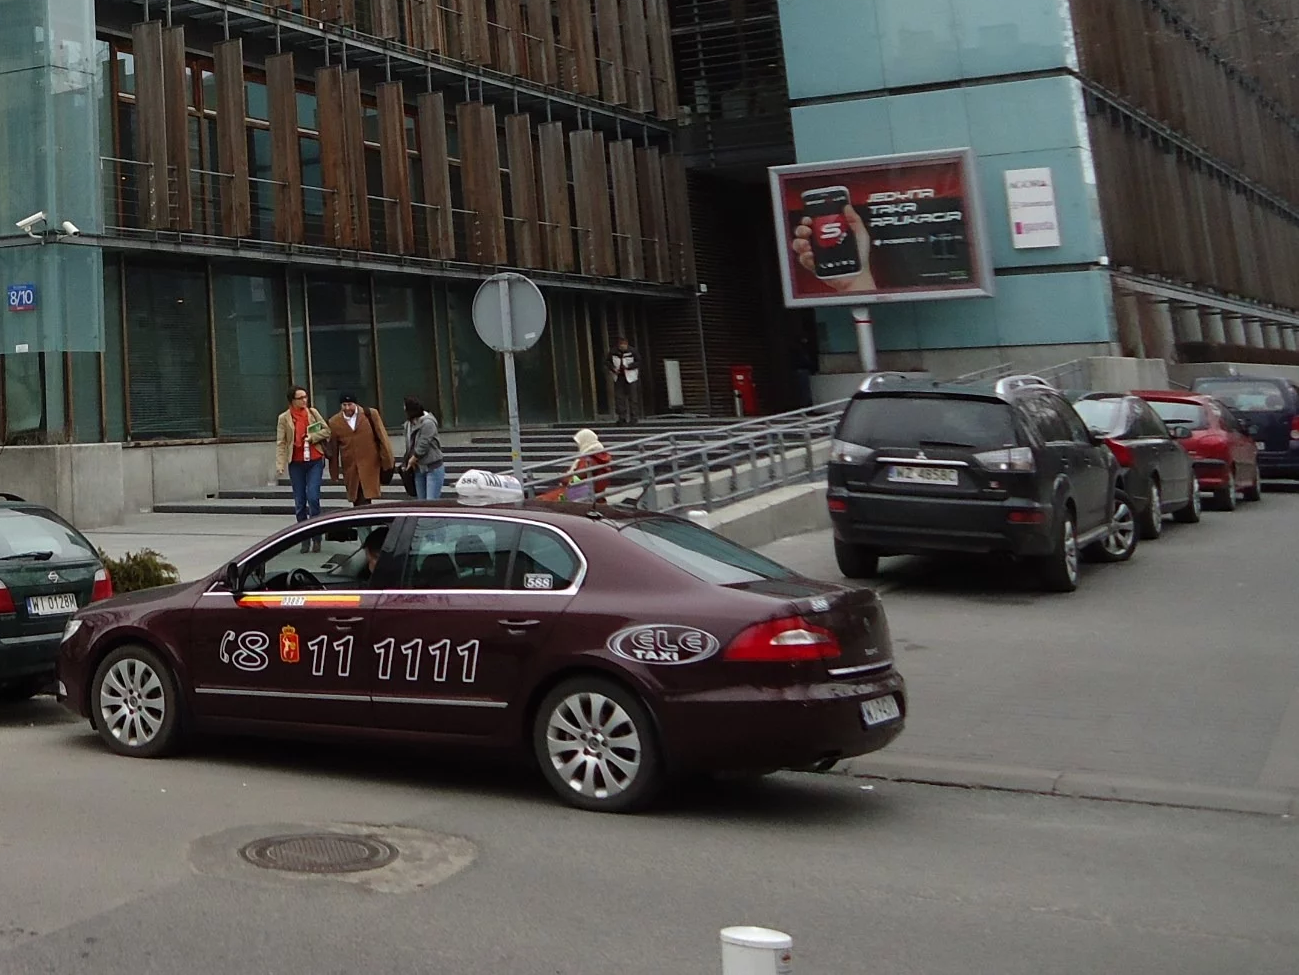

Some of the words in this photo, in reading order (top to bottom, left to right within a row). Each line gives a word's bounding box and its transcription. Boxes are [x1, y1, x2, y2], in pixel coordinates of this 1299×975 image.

[868, 202, 917, 215] TAKA
[9, 289, 34, 307] 8/10
[525, 577, 551, 589] 588
[47, 594, 77, 610] 0128M
[231, 630, 270, 672] 8
[307, 634, 354, 677] 11
[373, 637, 480, 683] 1111
[632, 649, 679, 662] TAXI
